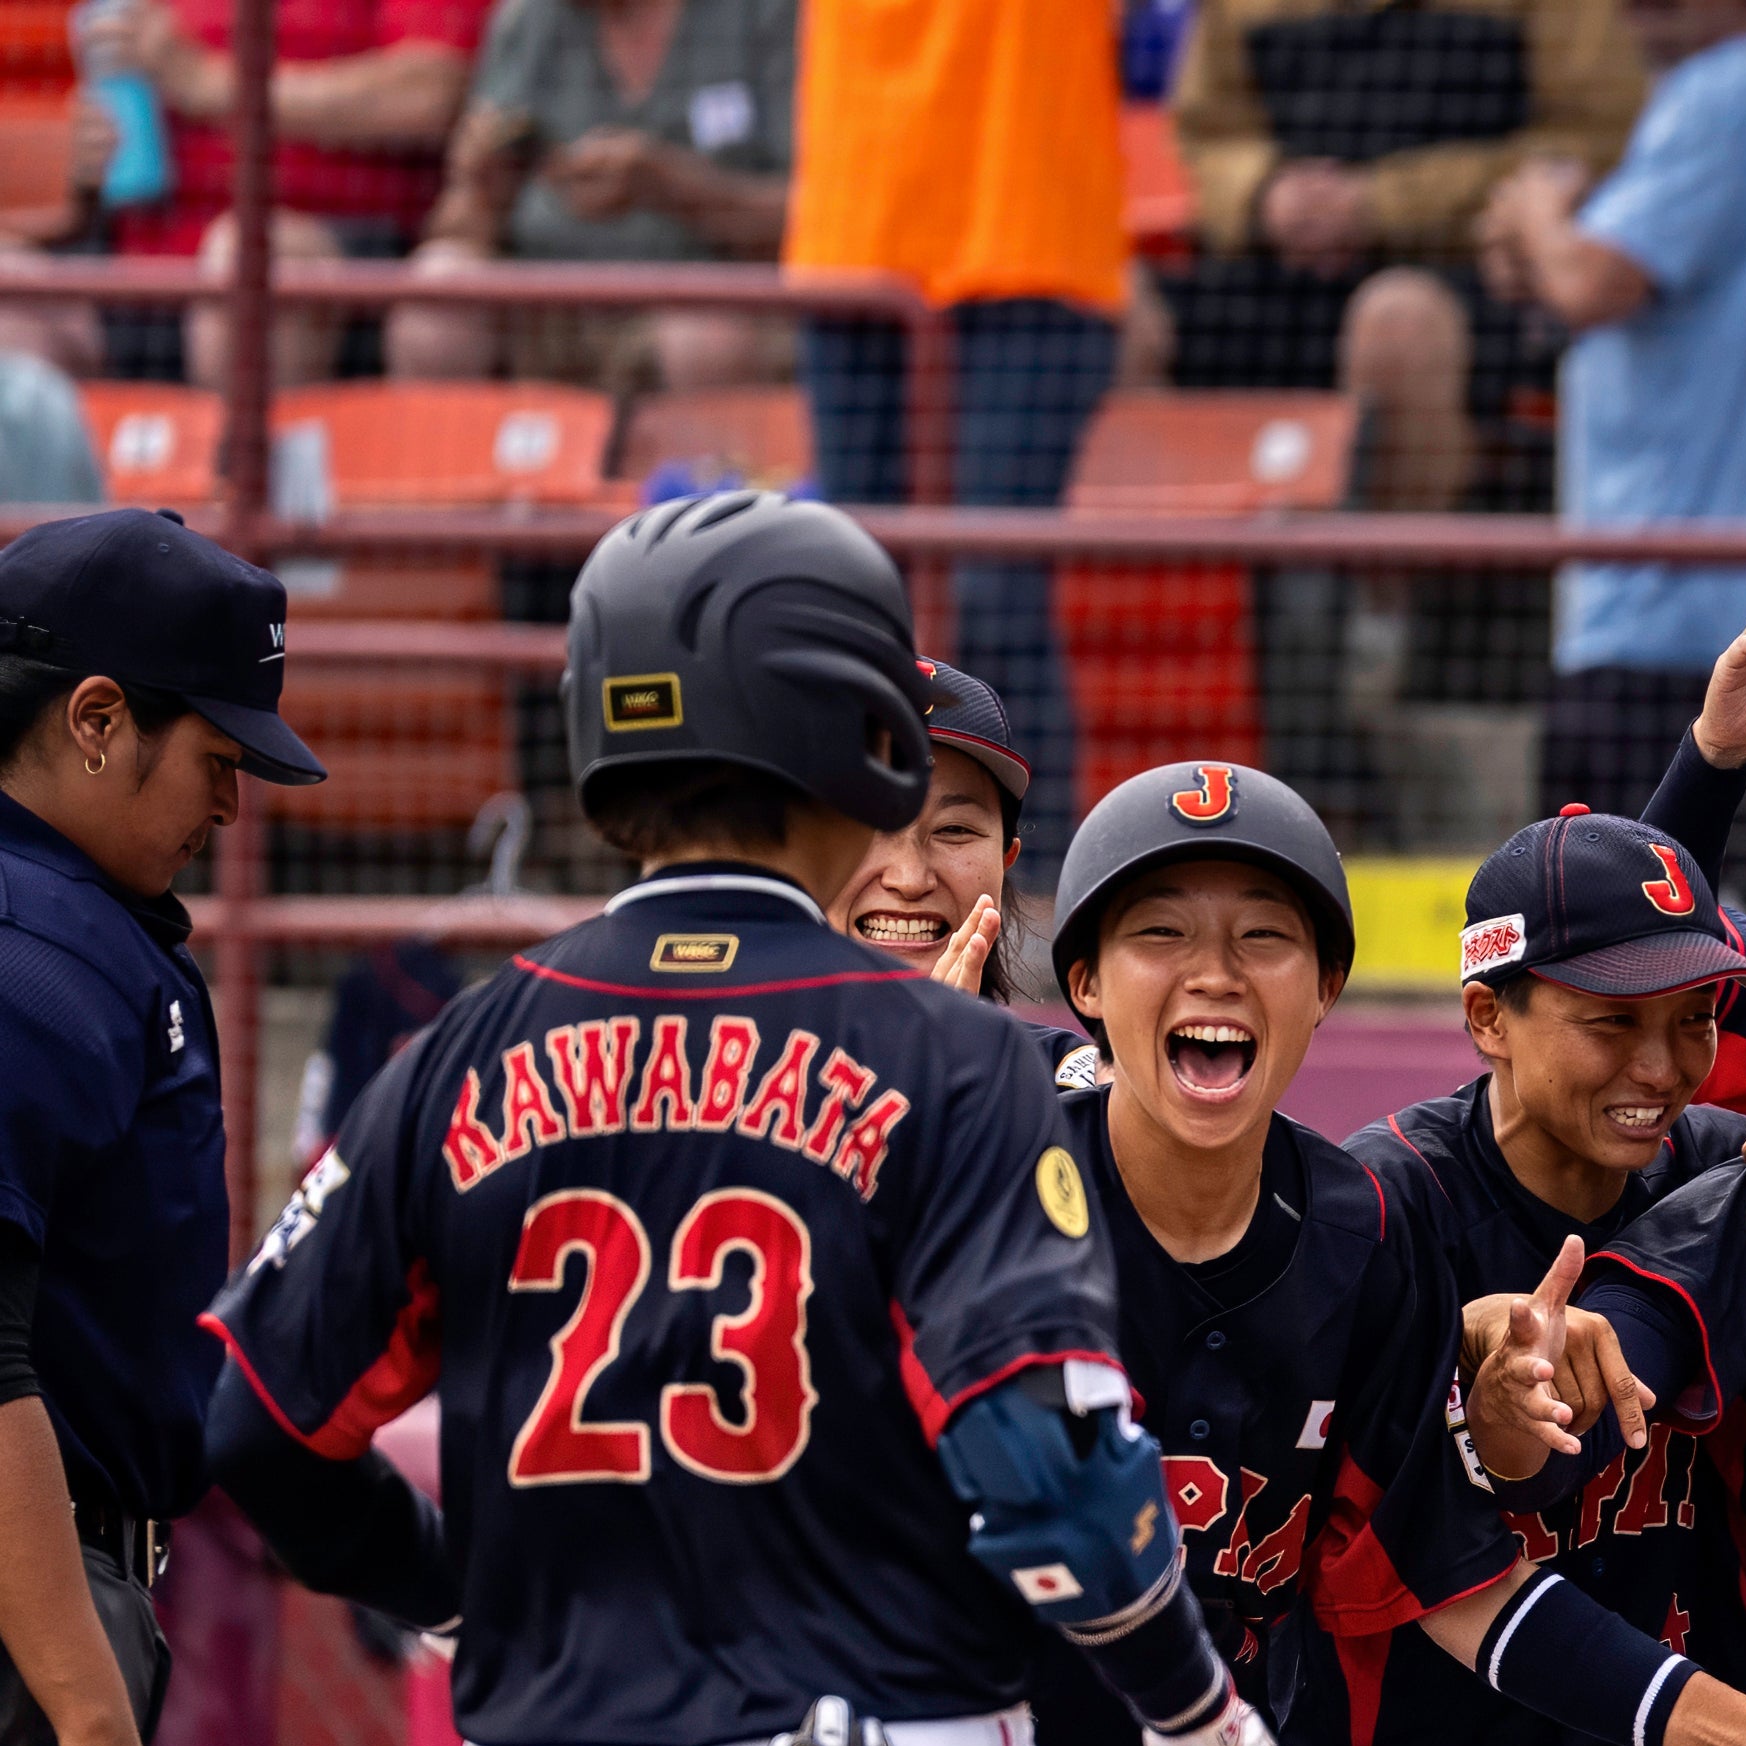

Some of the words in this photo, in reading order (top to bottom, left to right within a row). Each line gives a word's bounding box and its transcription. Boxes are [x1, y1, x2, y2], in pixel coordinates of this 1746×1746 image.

[1172, 765, 1236, 825] J
[1641, 842, 1696, 917] J
[441, 1014, 911, 1203] KAWABATA
[508, 1186, 819, 1488] 23
